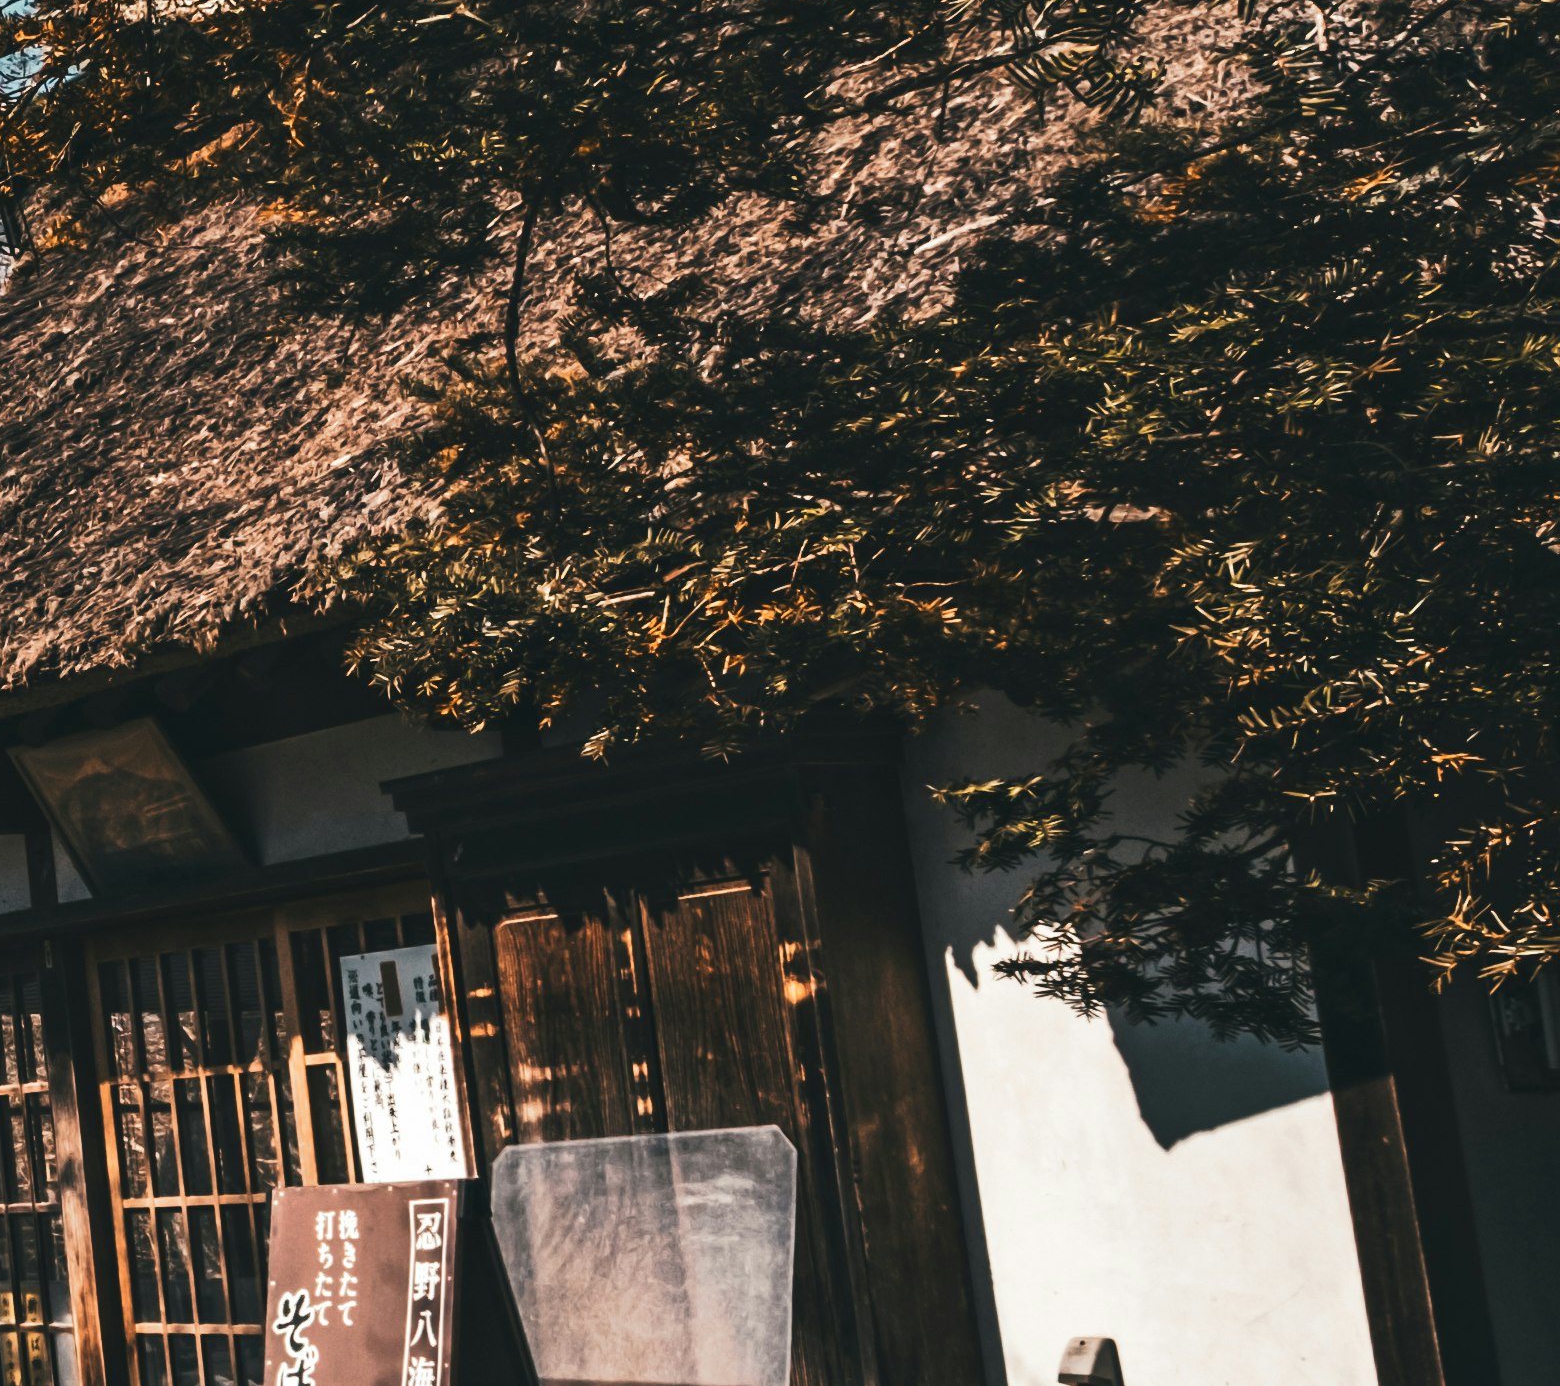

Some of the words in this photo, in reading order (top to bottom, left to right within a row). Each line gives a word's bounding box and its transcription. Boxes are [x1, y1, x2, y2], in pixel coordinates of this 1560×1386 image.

[313, 1210, 336, 1326] 打ちたて
[337, 1210, 360, 1326] 挽きたて
